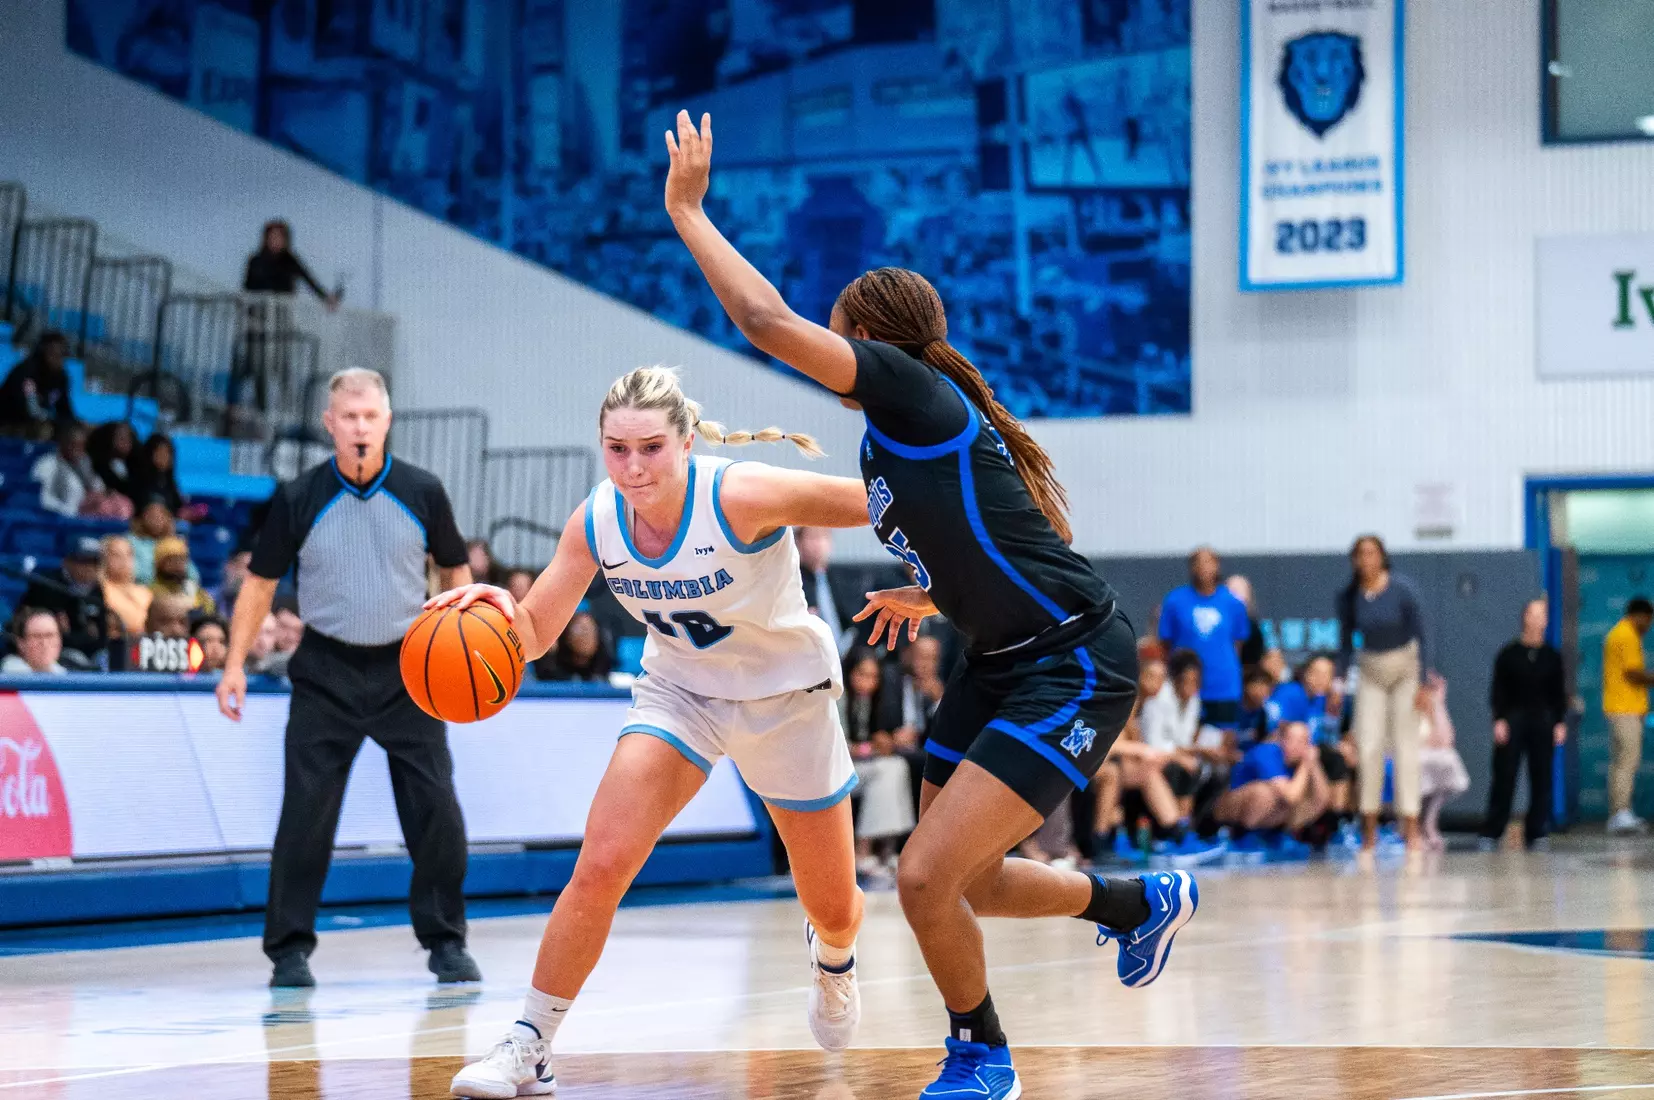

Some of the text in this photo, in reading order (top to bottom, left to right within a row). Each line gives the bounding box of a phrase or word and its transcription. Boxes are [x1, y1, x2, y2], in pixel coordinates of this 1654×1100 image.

[1275, 217, 1366, 253] 2023
[607, 568, 734, 600] COLUMBIA
[140, 637, 188, 670] POSS
